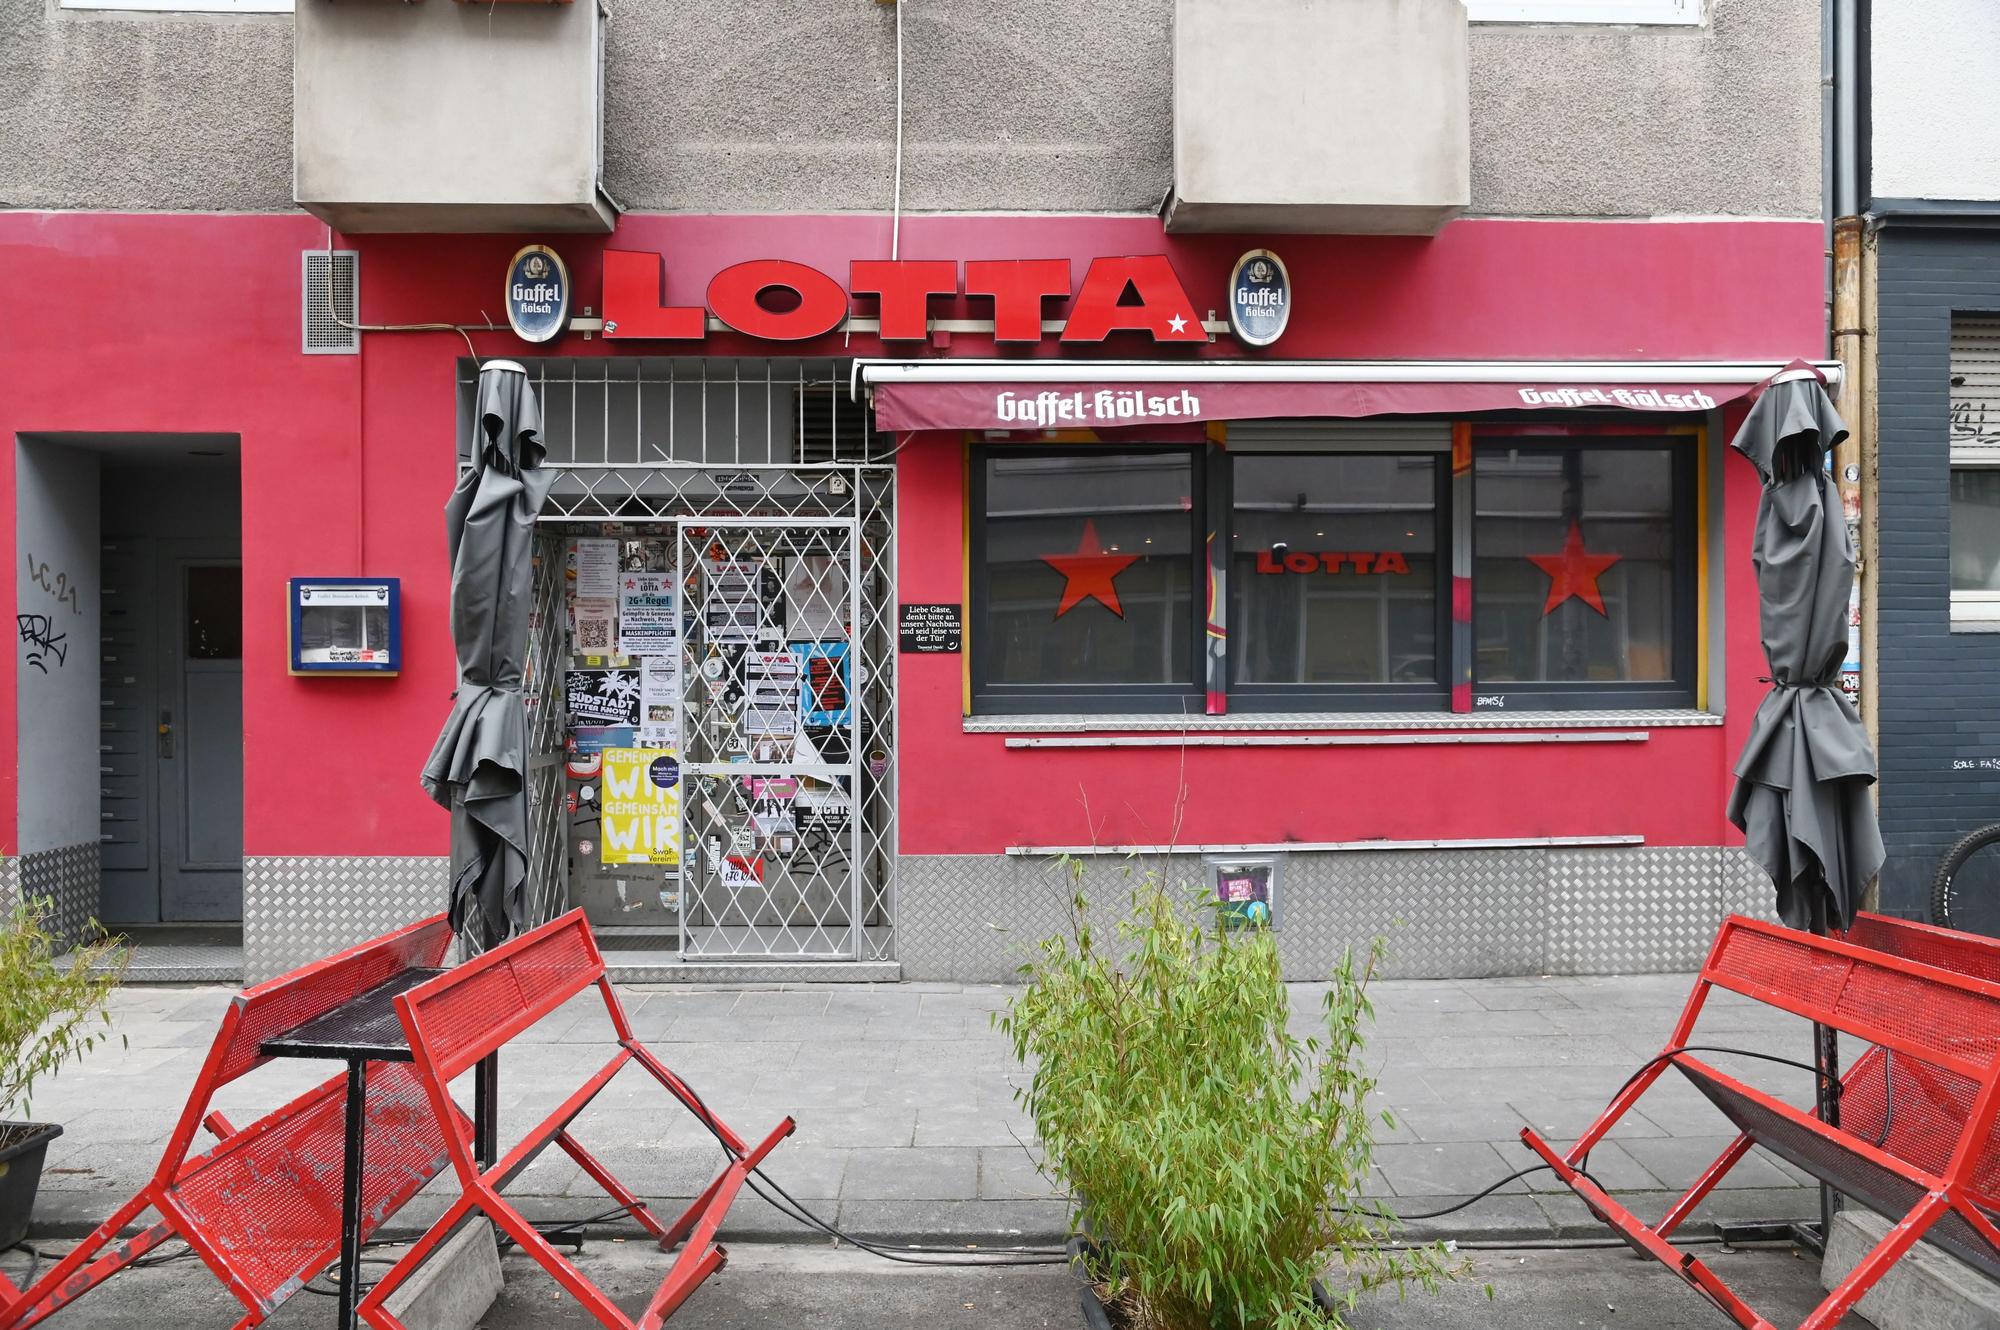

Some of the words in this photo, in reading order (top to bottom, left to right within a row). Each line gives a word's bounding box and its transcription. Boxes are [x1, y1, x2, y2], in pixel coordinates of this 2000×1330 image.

[512, 283, 561, 303] Gaffel
[602, 249, 1209, 342] LOTTA
[1237, 287, 1284, 307] Gaffel
[521, 302, 551, 314] Kölsch
[1245, 306, 1275, 318] Kölsch
[996, 389, 1201, 427] Gaffel-Kölsch
[1517, 388, 1717, 410] Gaffel-Kölsch
[1256, 549, 1410, 575] LOTTA
[628, 597, 644, 605] 2G+
[645, 596, 669, 607] Regel
[930, 606, 952, 614] Gäste,
[929, 634, 945, 642] Tür!
[568, 692, 635, 710] SÜDSTADT
[569, 701, 599, 712] BETTER
[600, 706, 631, 717] KNOW!
[605, 801, 678, 816] GEMEINSAM
[604, 815, 680, 852] WIR
